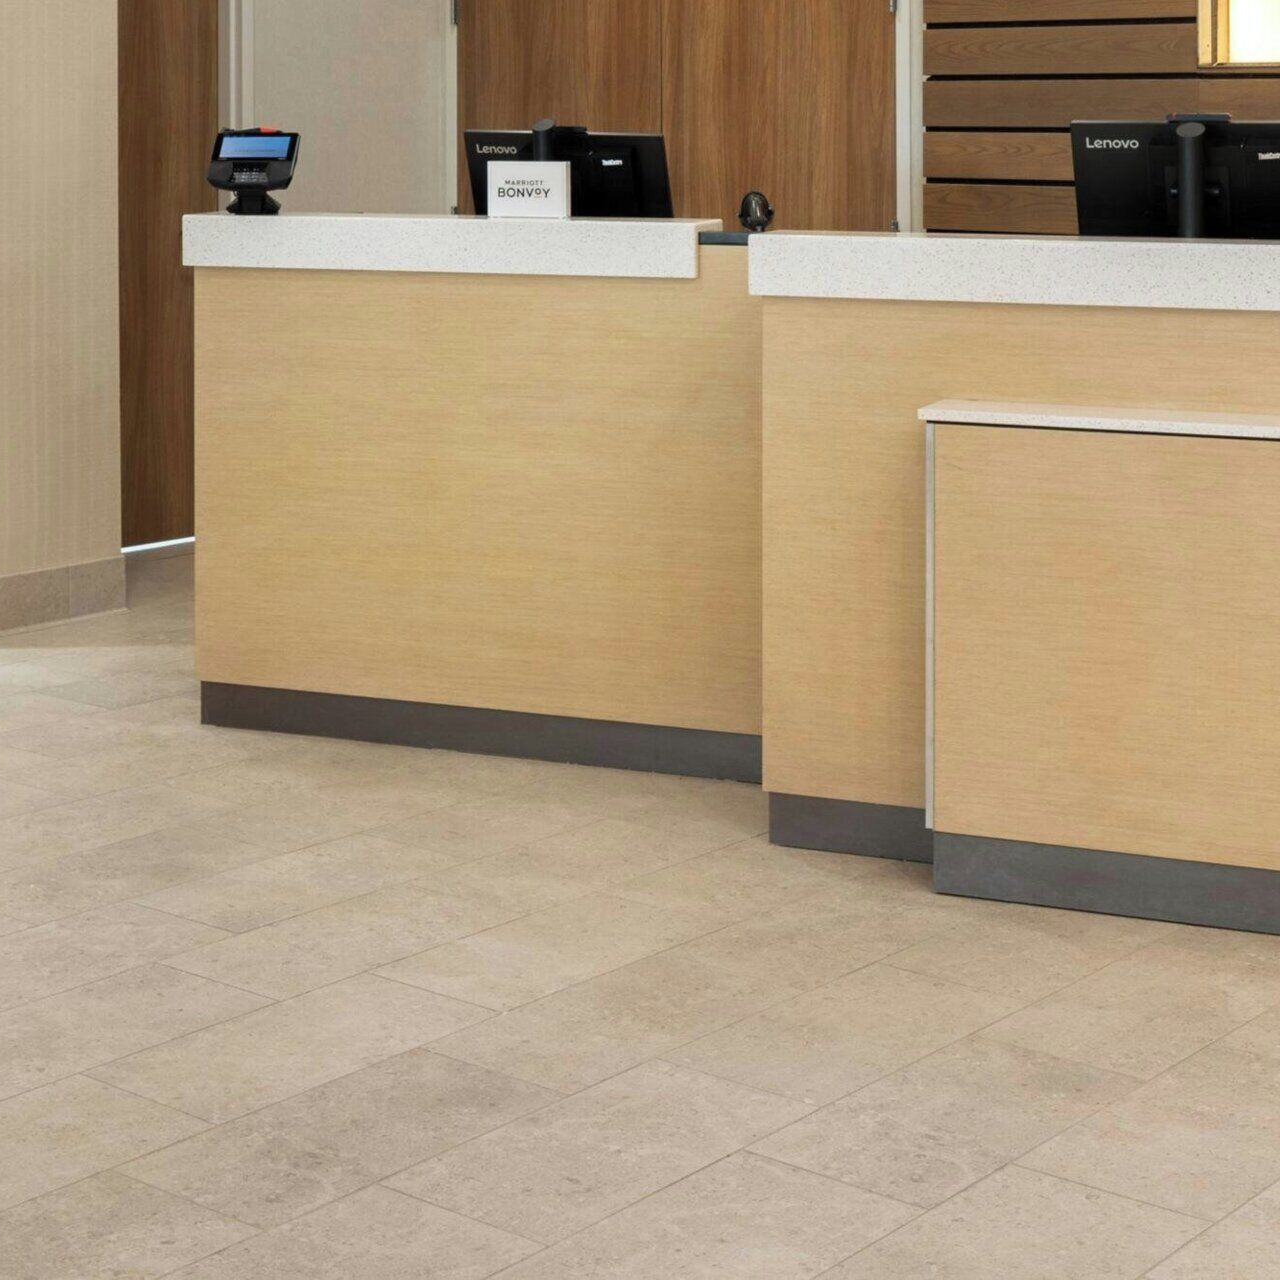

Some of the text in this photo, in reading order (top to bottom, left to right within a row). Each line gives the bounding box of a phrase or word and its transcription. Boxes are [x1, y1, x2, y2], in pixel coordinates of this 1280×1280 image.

[475, 143, 518, 155] Lenovo
[1085, 136, 1140, 150] Lenovo
[497, 187, 551, 198] BONVOY
